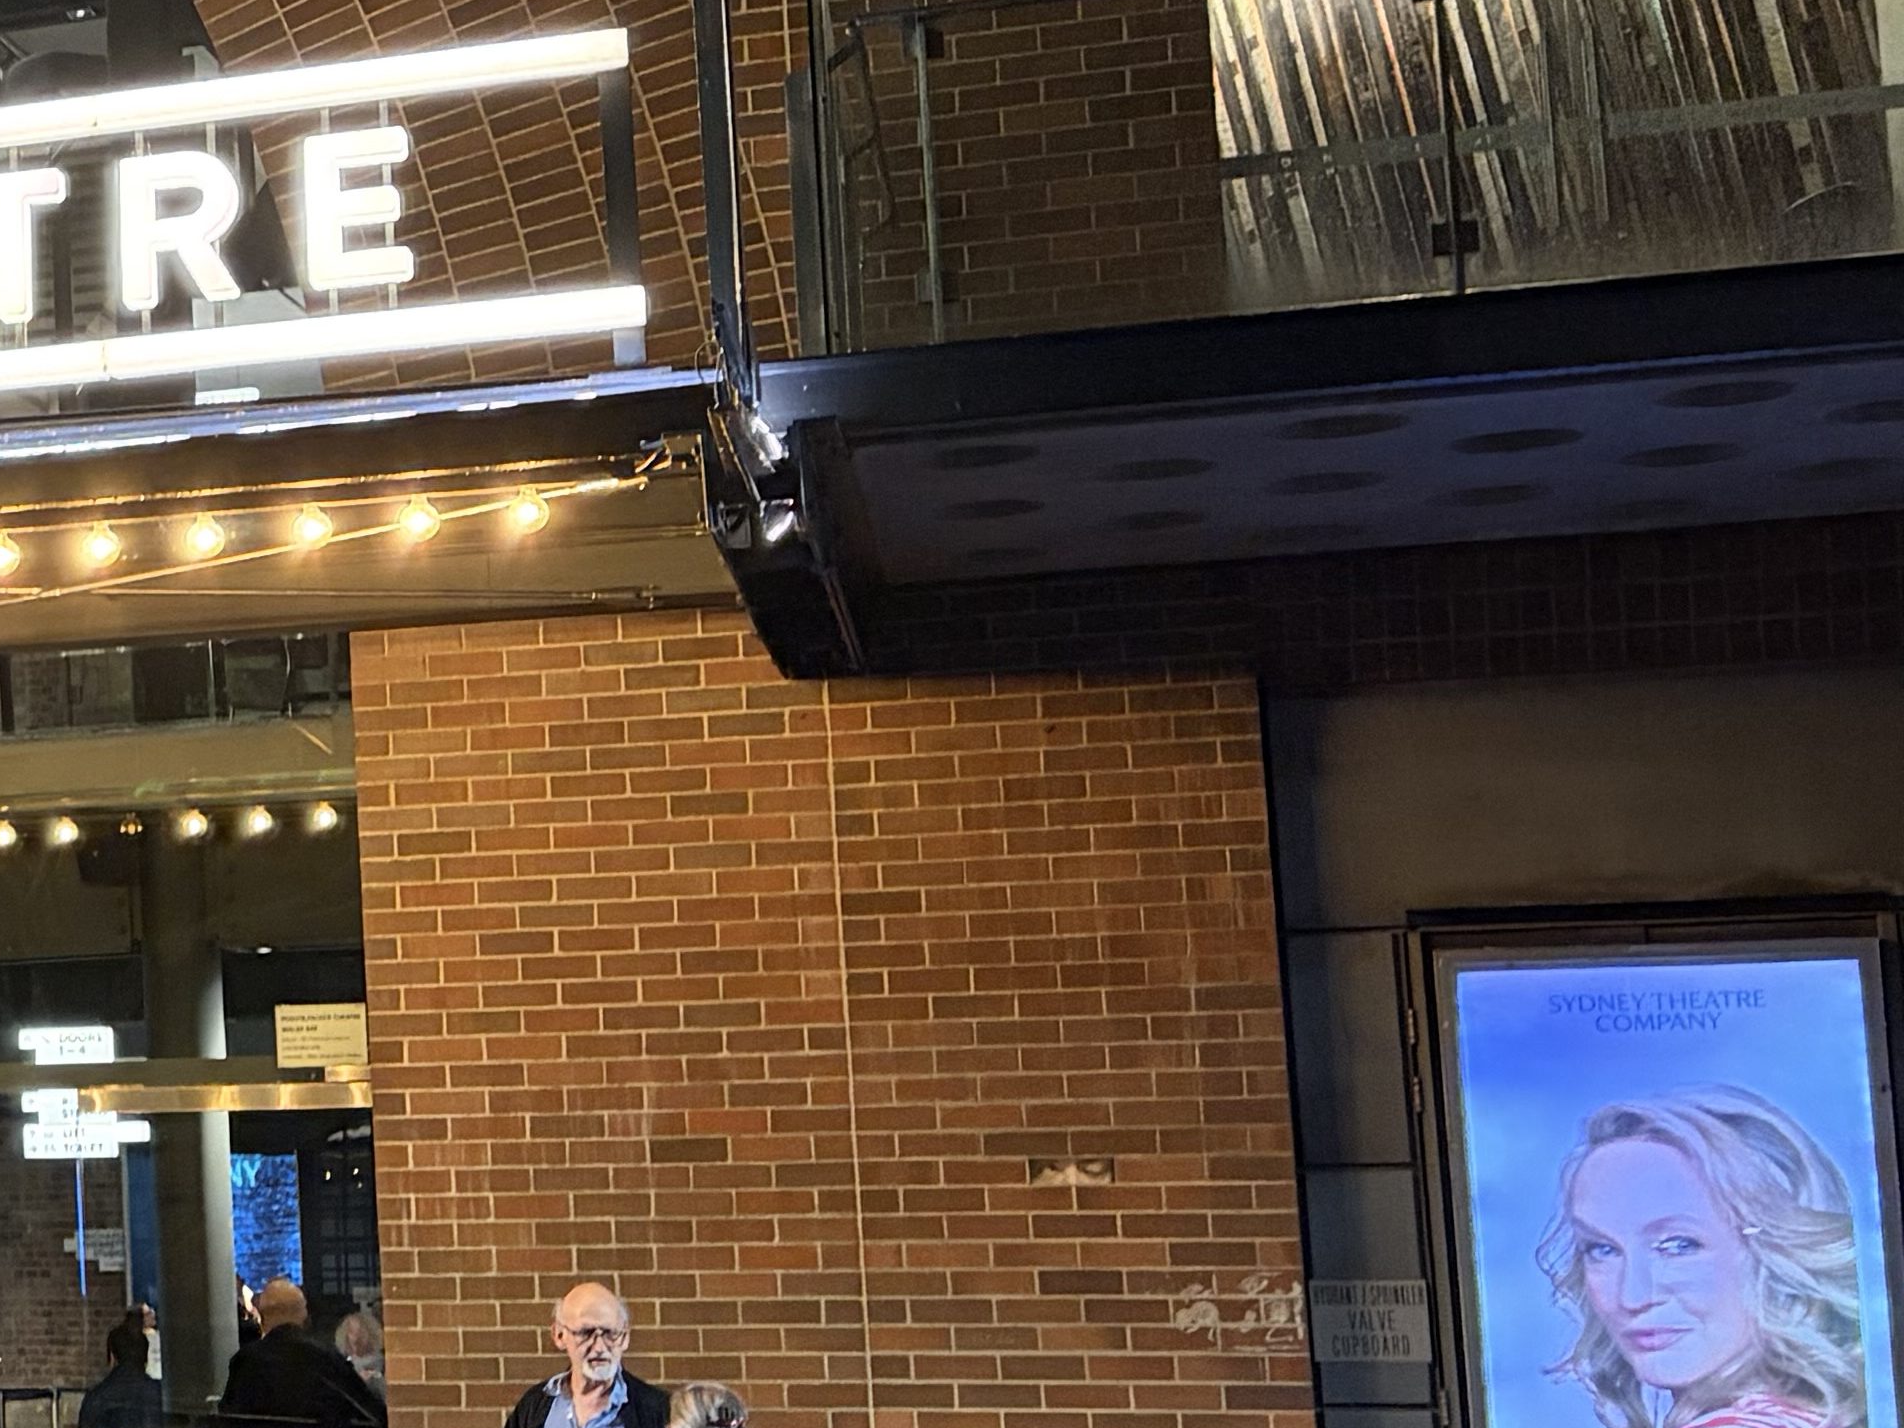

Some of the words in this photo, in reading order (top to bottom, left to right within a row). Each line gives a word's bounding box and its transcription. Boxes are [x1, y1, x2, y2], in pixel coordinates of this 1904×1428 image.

[1548, 992, 1644, 1014] SYDNEY
[1650, 989, 1767, 1012] THEATRE
[1595, 1011, 1723, 1033] COMPANY
[1347, 1308, 1396, 1332] VALVE
[1331, 1334, 1411, 1358] CUPBOARD
